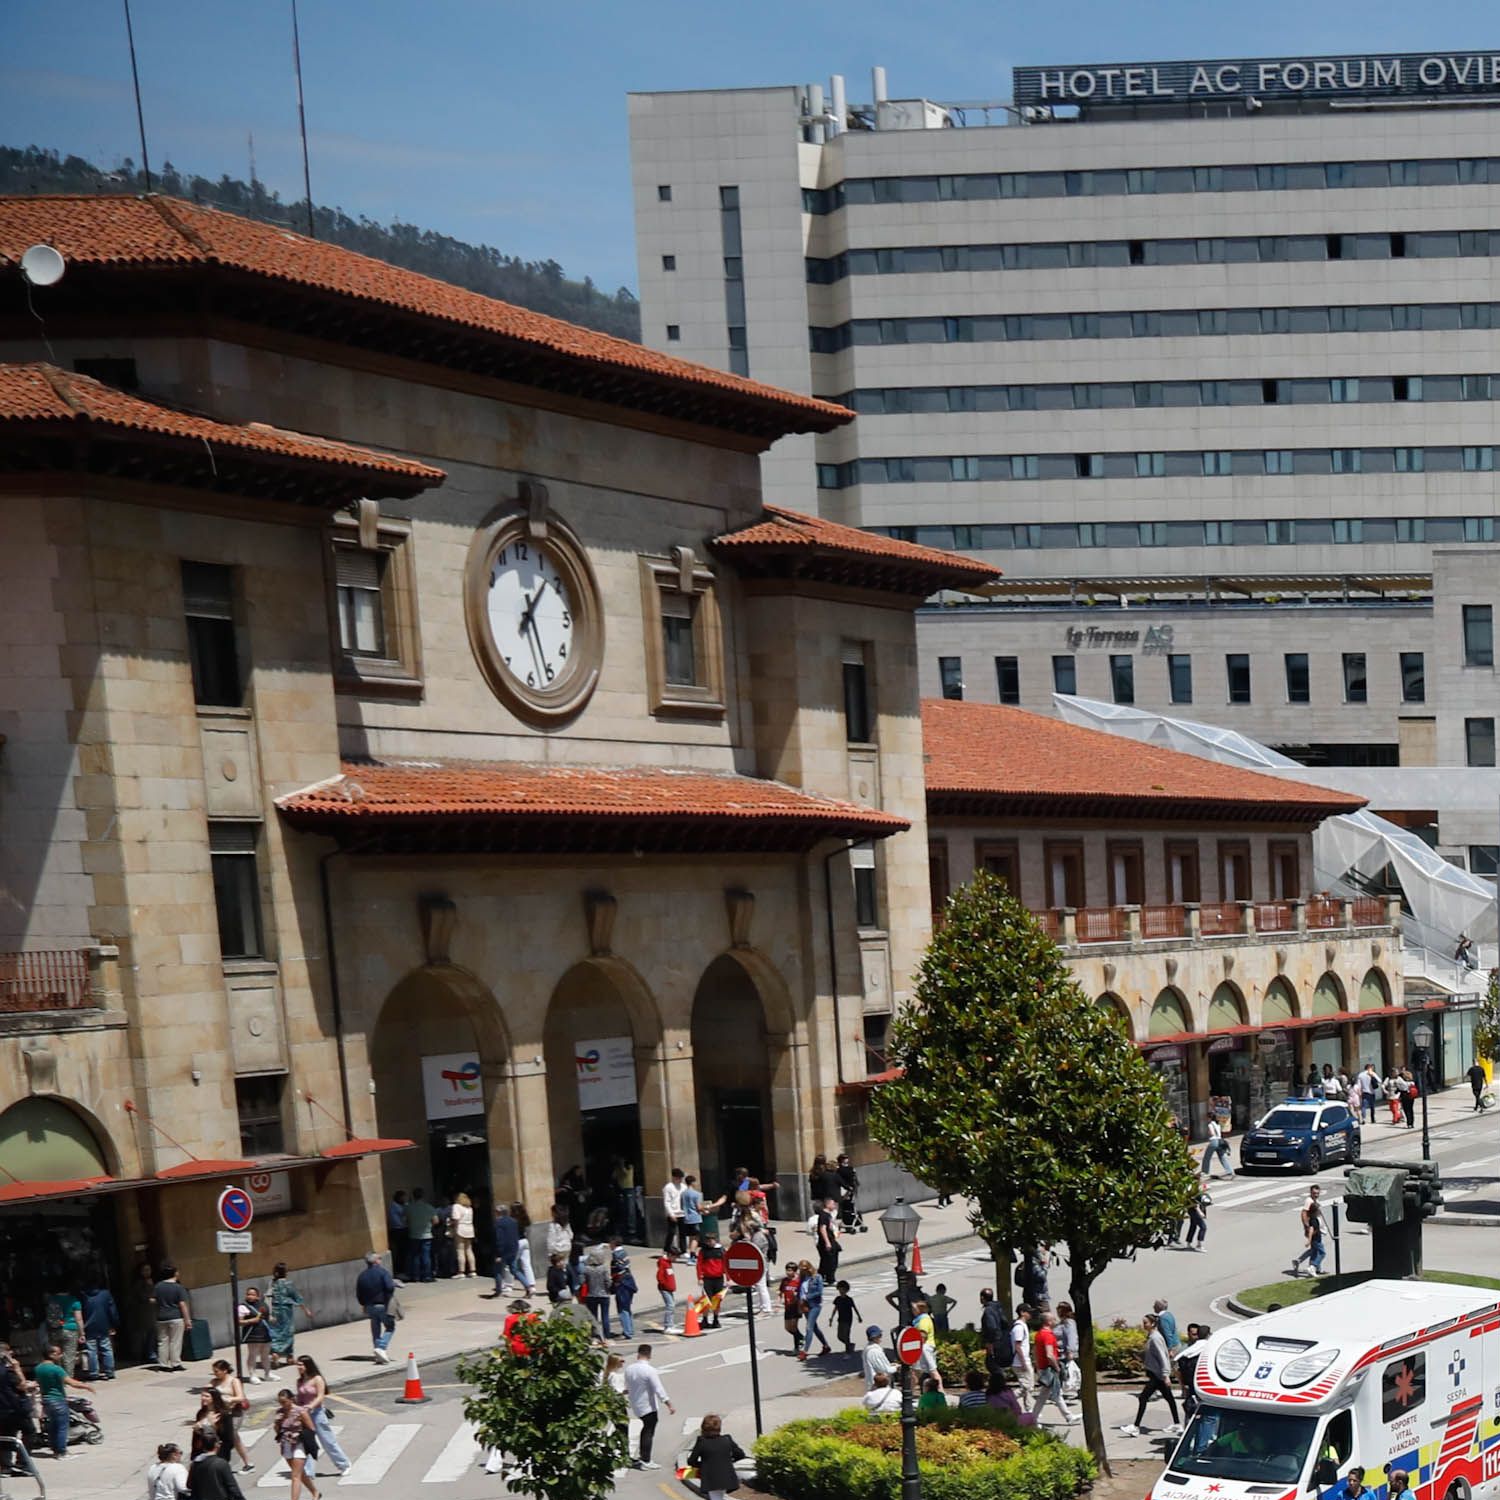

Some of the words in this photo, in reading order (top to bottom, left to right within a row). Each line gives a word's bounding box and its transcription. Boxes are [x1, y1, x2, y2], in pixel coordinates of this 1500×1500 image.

[1040, 68, 1175, 99] HOTEL
[1188, 65, 1242, 94] AC
[1257, 58, 1402, 91] FORUM
[515, 543, 528, 561] 12
[554, 577, 563, 595] 2
[558, 643, 567, 658] 4
[527, 671, 535, 687] 6
[1447, 1388, 1467, 1403] SESPA
[1391, 1414, 1417, 1432] SOPORTE
[1395, 1428, 1413, 1441] VITAL
[1388, 1436, 1420, 1456] AVANZADO
